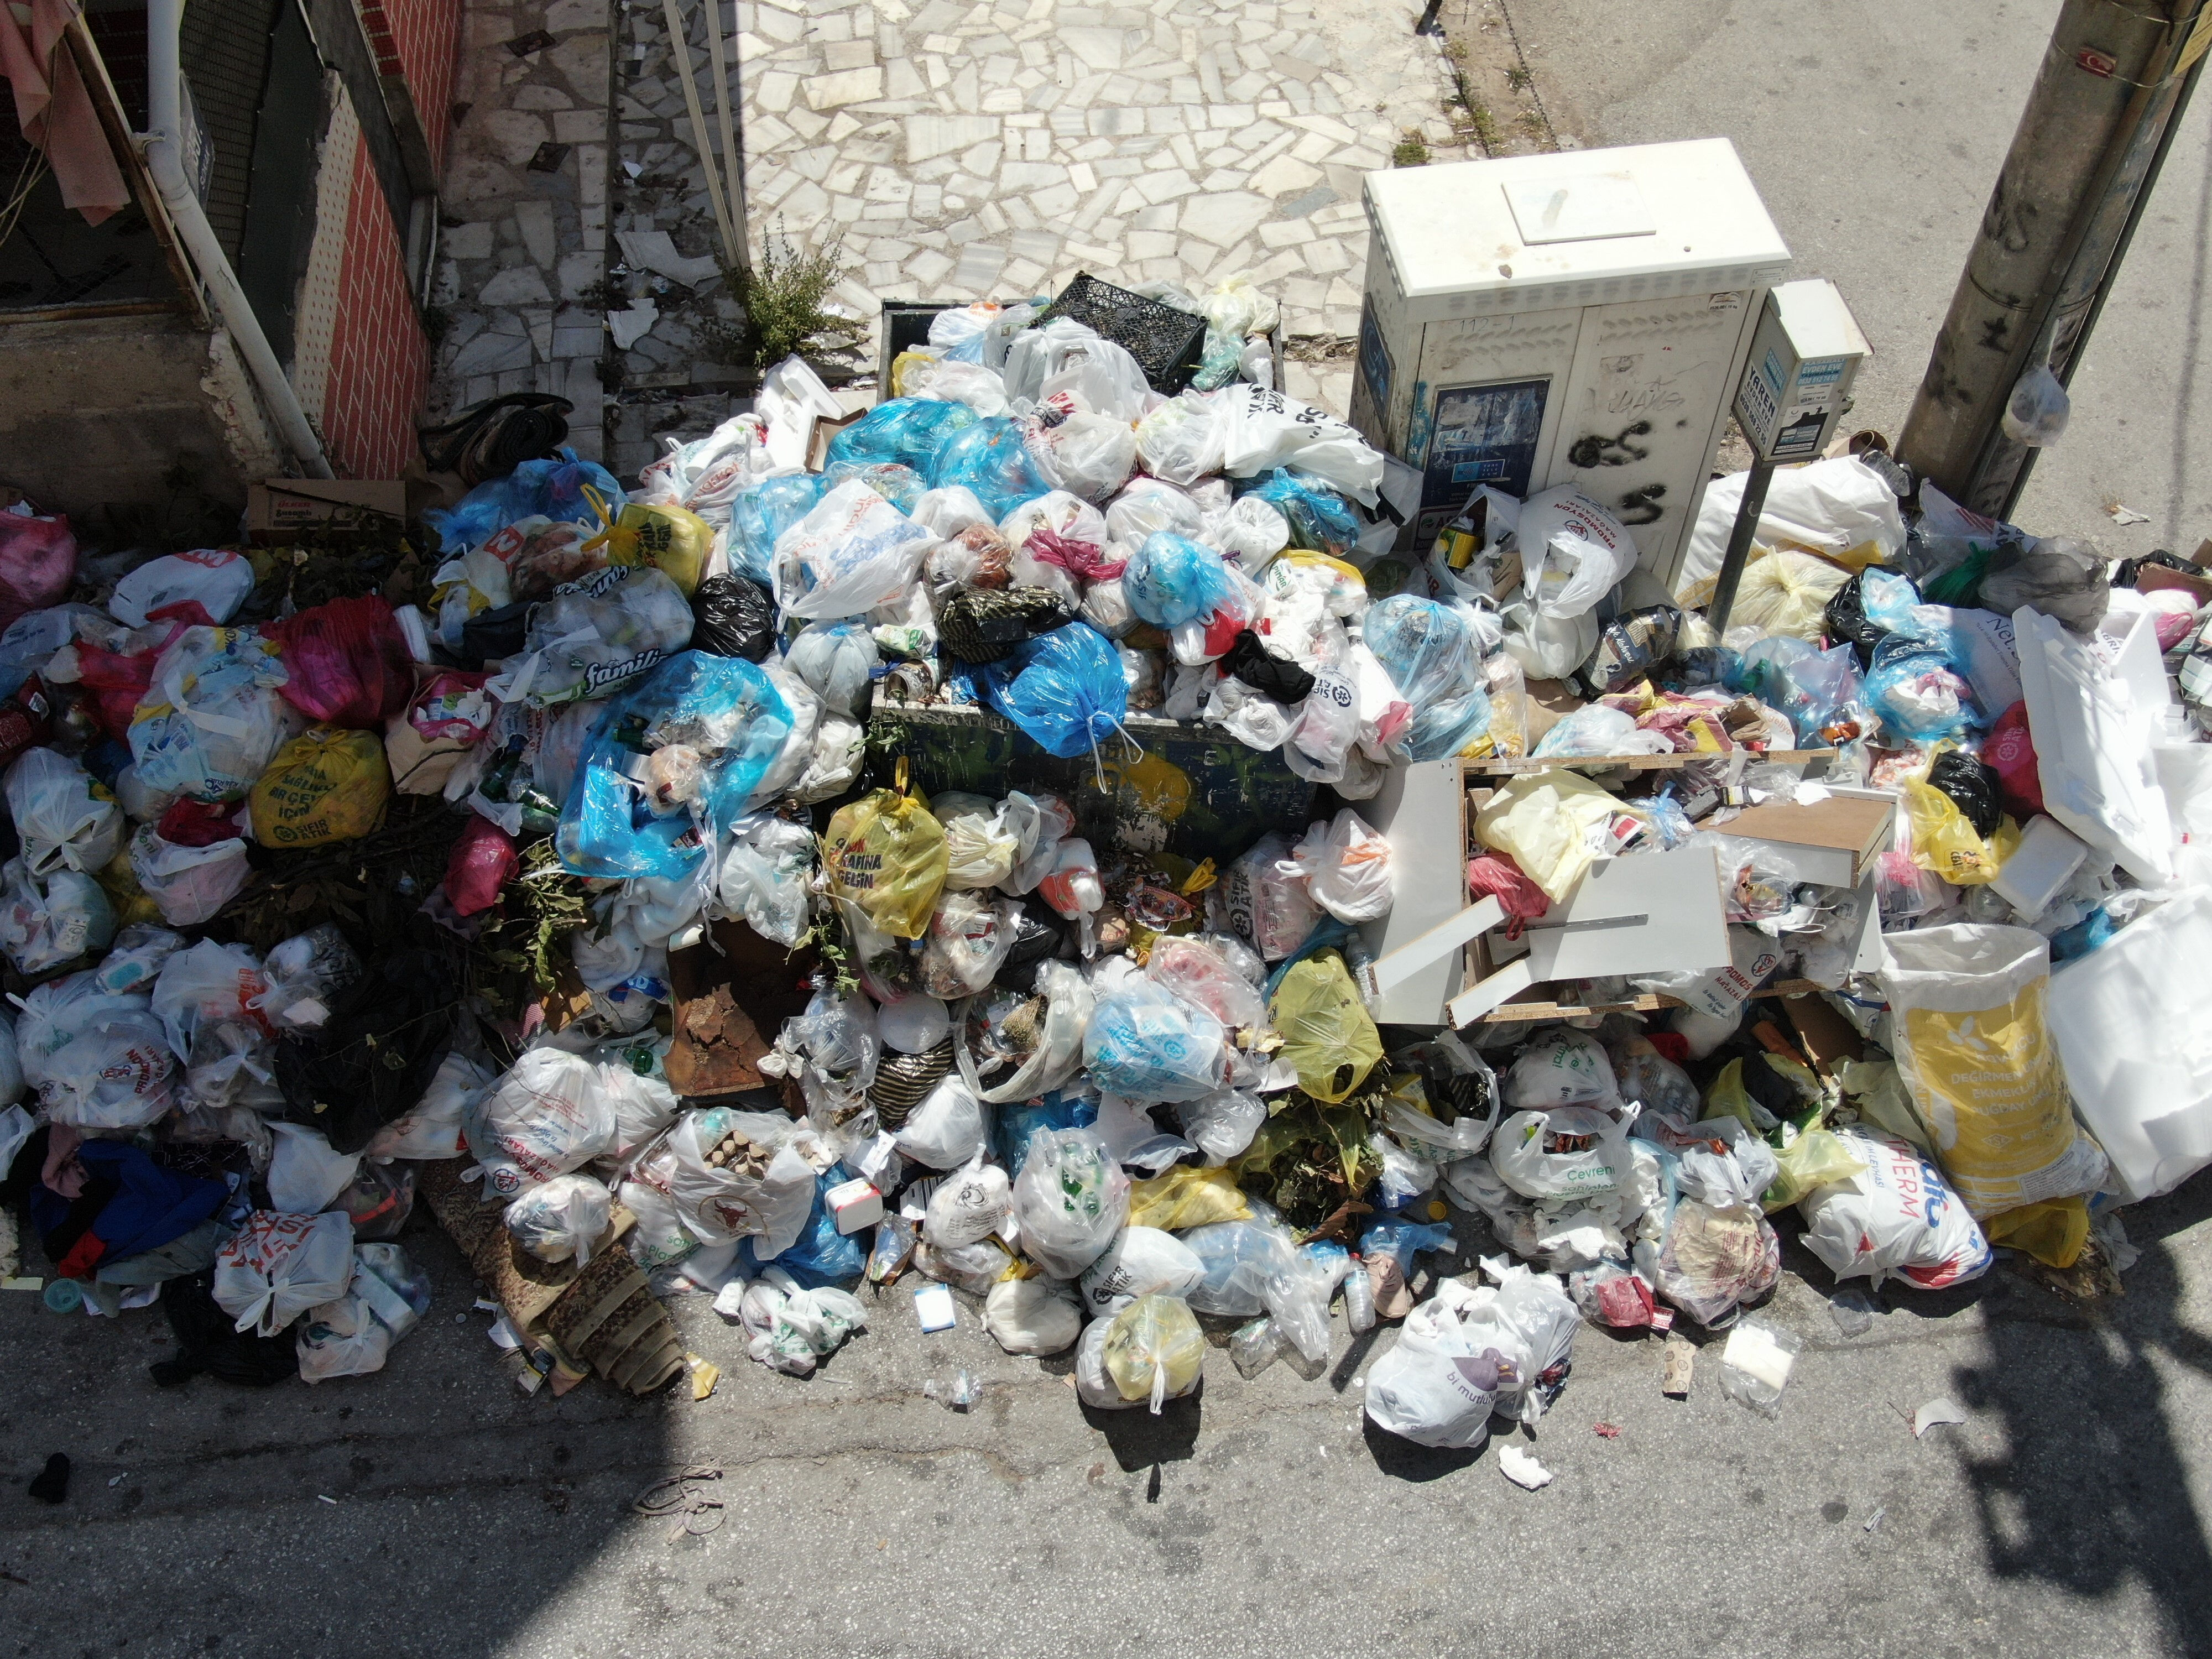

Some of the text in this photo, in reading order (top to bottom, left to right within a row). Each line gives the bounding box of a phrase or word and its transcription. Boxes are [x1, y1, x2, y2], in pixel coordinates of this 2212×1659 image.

[1746, 382, 1762, 408] EVDEN
[1761, 408, 1771, 426] EVE
[1749, 366, 1776, 418] YAREN
[1553, 503, 1616, 550] PROMOSYON
[1615, 638, 1635, 664] Kahvesi
[584, 649, 668, 693] famili
[1567, 1165, 1616, 1183] Çevreni
[1112, 1271, 1133, 1293] ATIK
[1446, 1371, 1496, 1405] bi mutlulu
